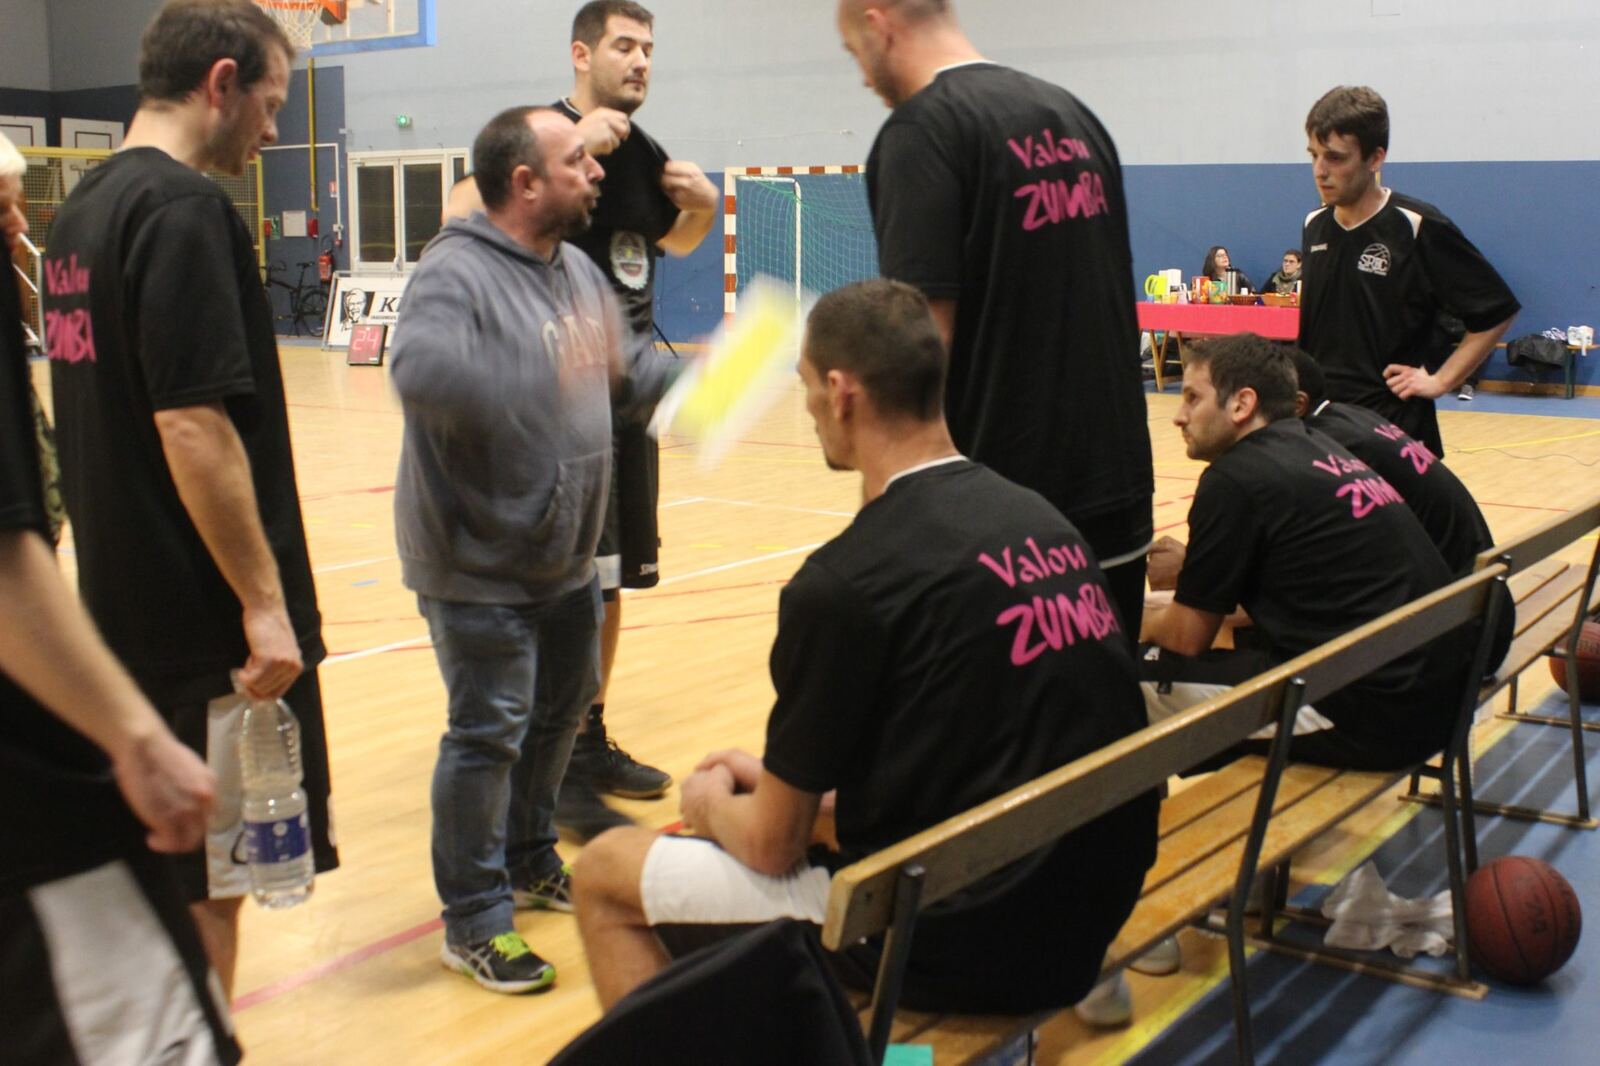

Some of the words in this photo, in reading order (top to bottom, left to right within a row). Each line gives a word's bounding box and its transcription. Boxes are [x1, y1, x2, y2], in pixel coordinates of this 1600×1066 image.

[1014, 171, 1108, 231] ZUMBA
[351, 328, 381, 352] 24
[996, 582, 1120, 667] ZUMBA
